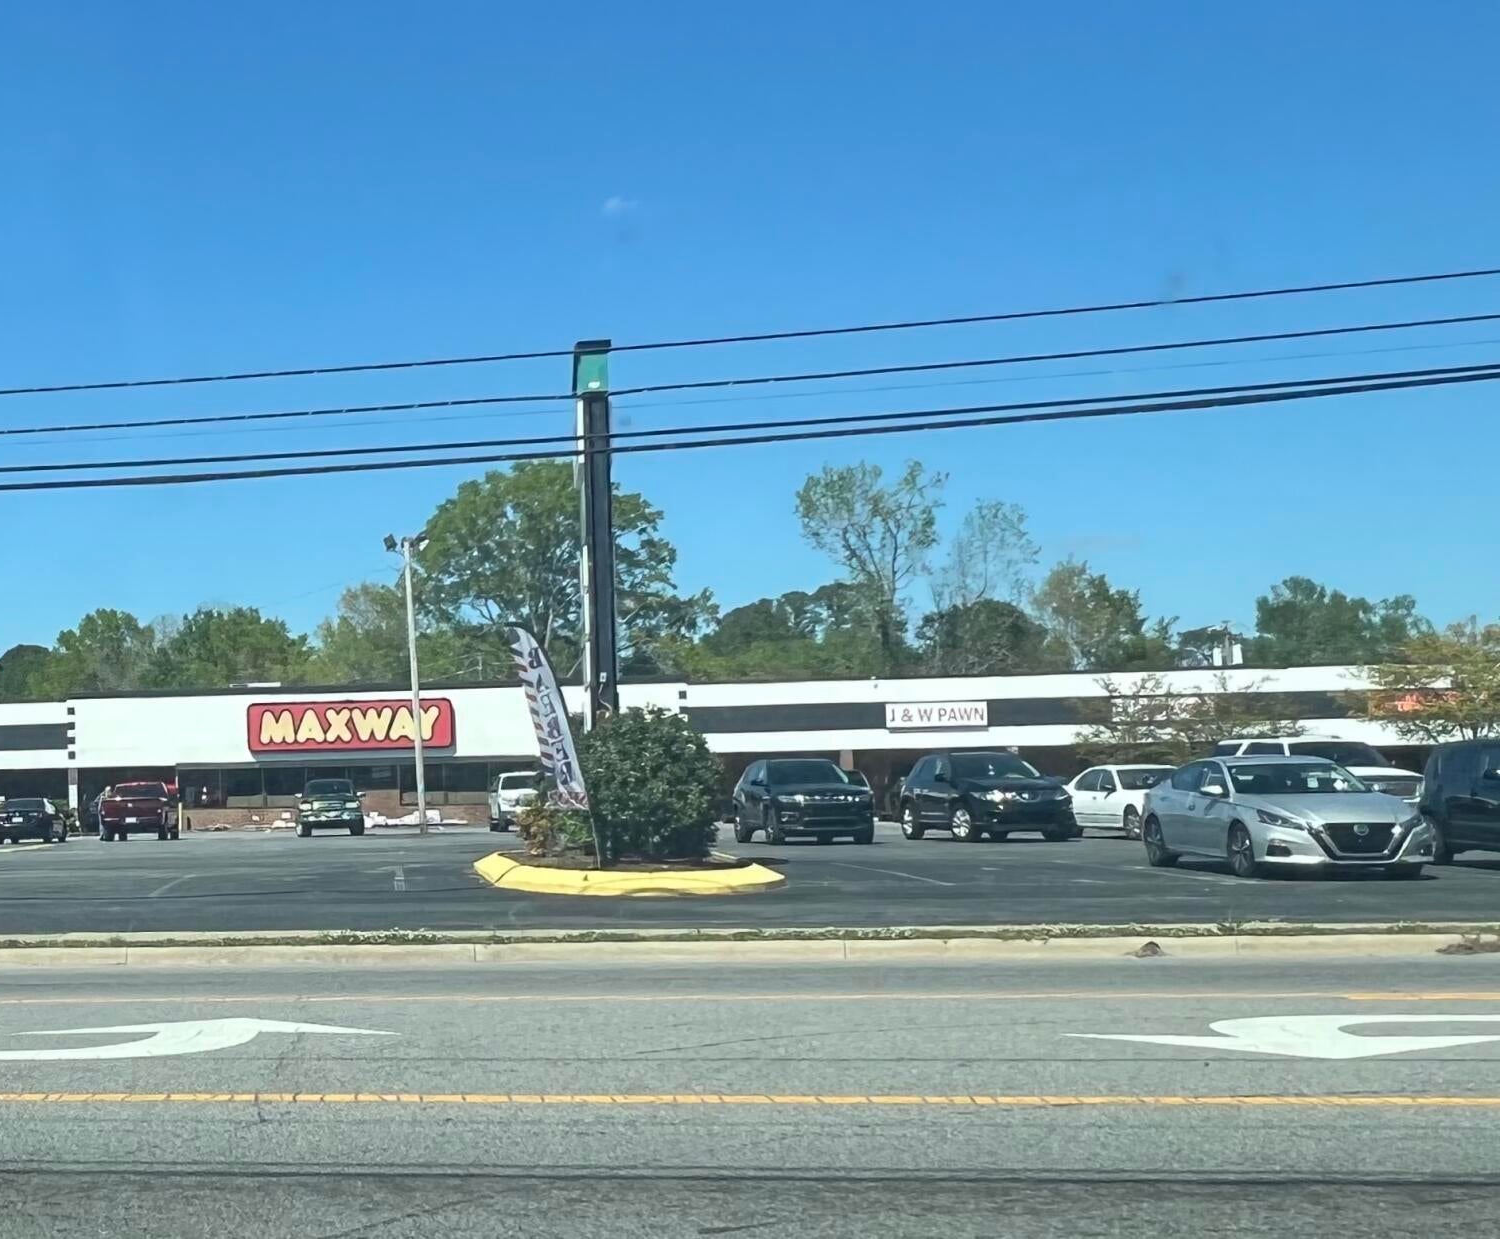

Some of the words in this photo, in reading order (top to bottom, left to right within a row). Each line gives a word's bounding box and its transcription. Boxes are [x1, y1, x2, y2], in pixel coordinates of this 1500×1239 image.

[259, 704, 441, 745] MAXWAY
[889, 708, 896, 722] J
[901, 708, 913, 722] &
[917, 707, 933, 722] W
[938, 706, 985, 722] PAWN
